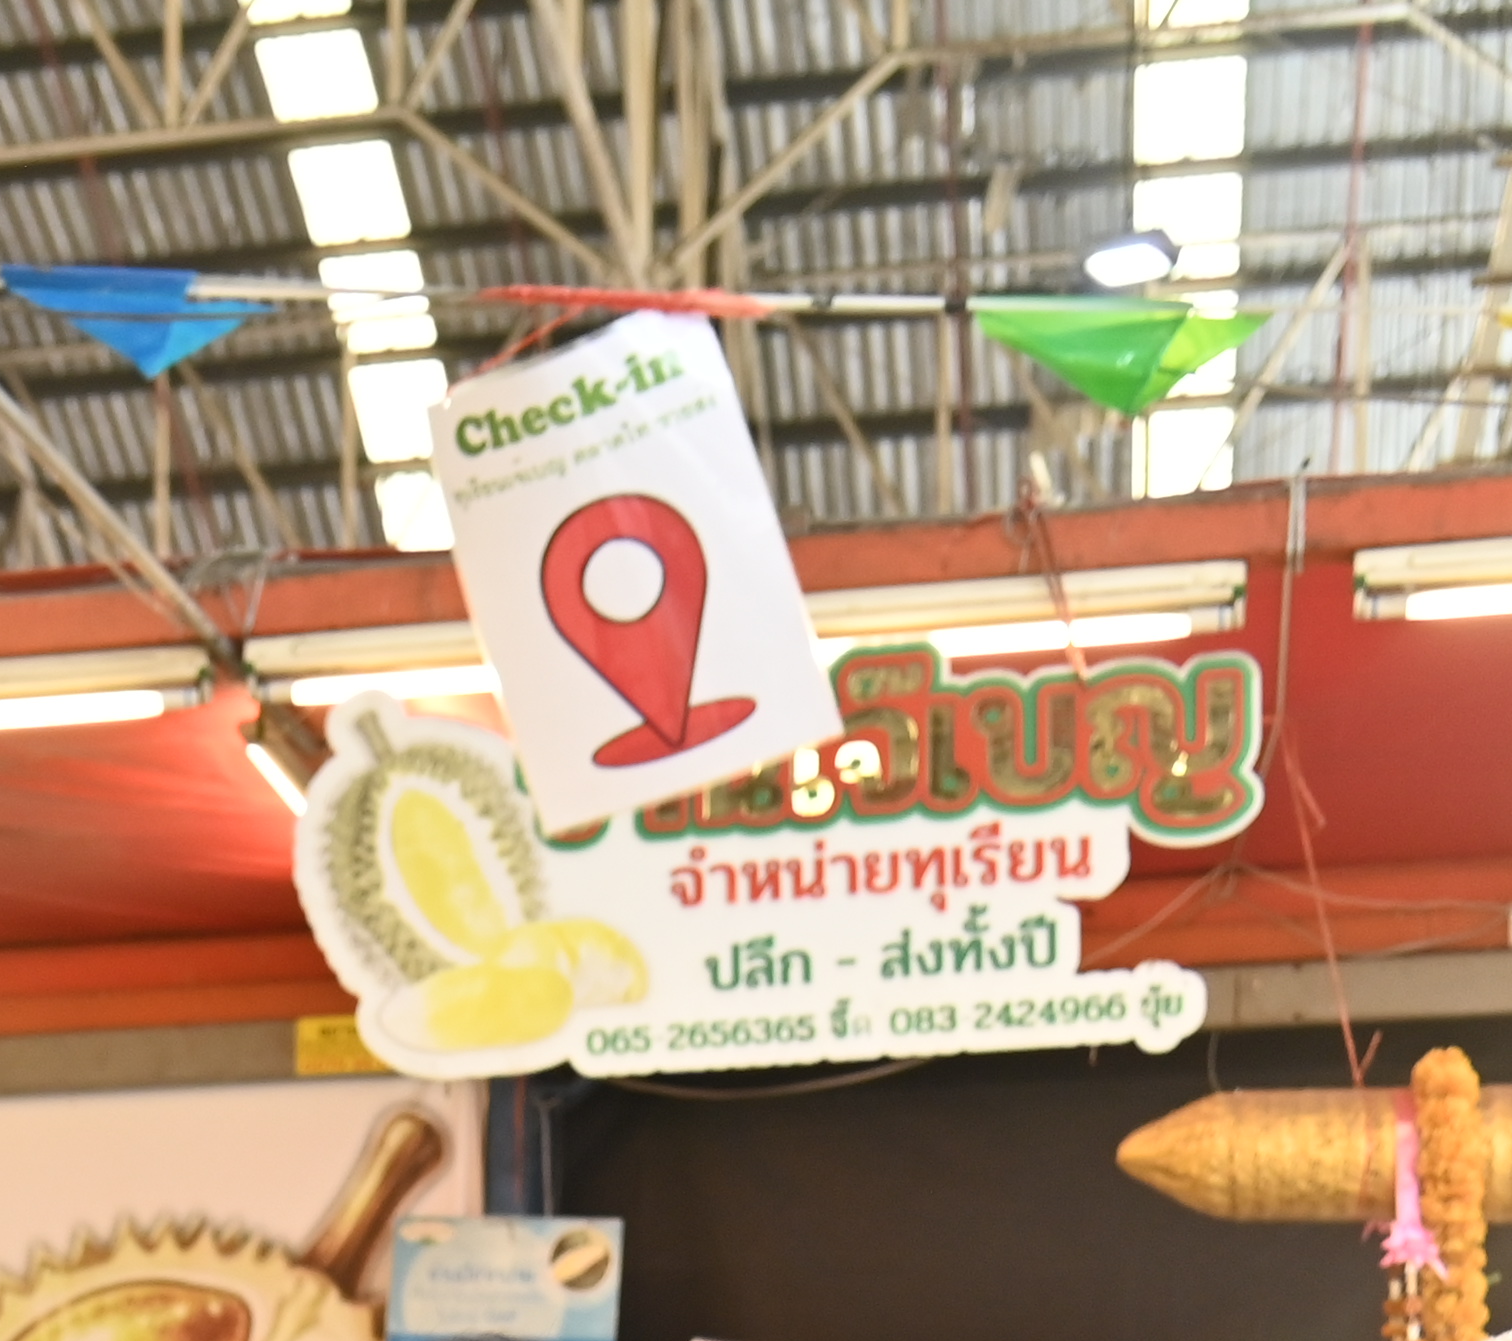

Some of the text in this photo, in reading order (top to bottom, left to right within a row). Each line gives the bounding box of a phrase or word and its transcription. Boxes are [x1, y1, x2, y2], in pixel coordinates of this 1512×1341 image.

[670, 820, 1094, 912] จำหน่ายทุเรียน
[704, 934, 814, 992] ปลีก
